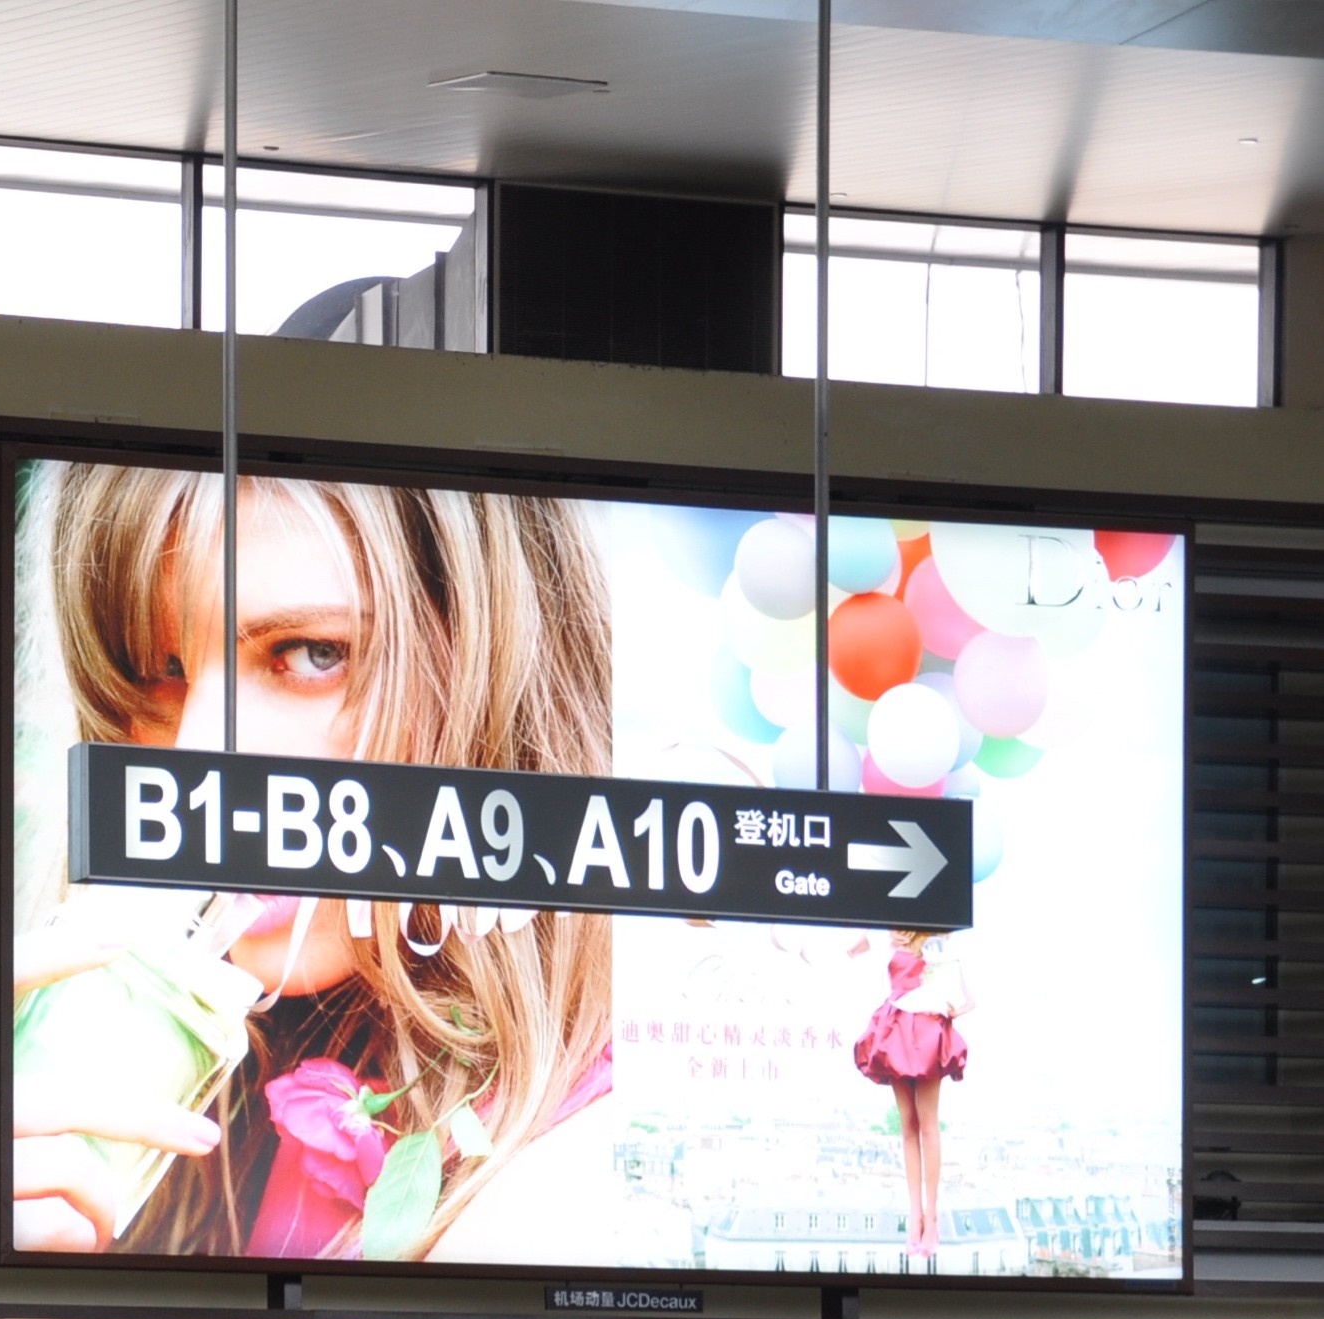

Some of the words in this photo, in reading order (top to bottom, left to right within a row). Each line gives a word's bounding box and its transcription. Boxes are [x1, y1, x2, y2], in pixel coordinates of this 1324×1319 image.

[1016, 534, 1173, 612] Dior
[734, 808, 833, 850] 登机口
[775, 868, 831, 897] Gate
[617, 1292, 697, 1310] JCDecaux
